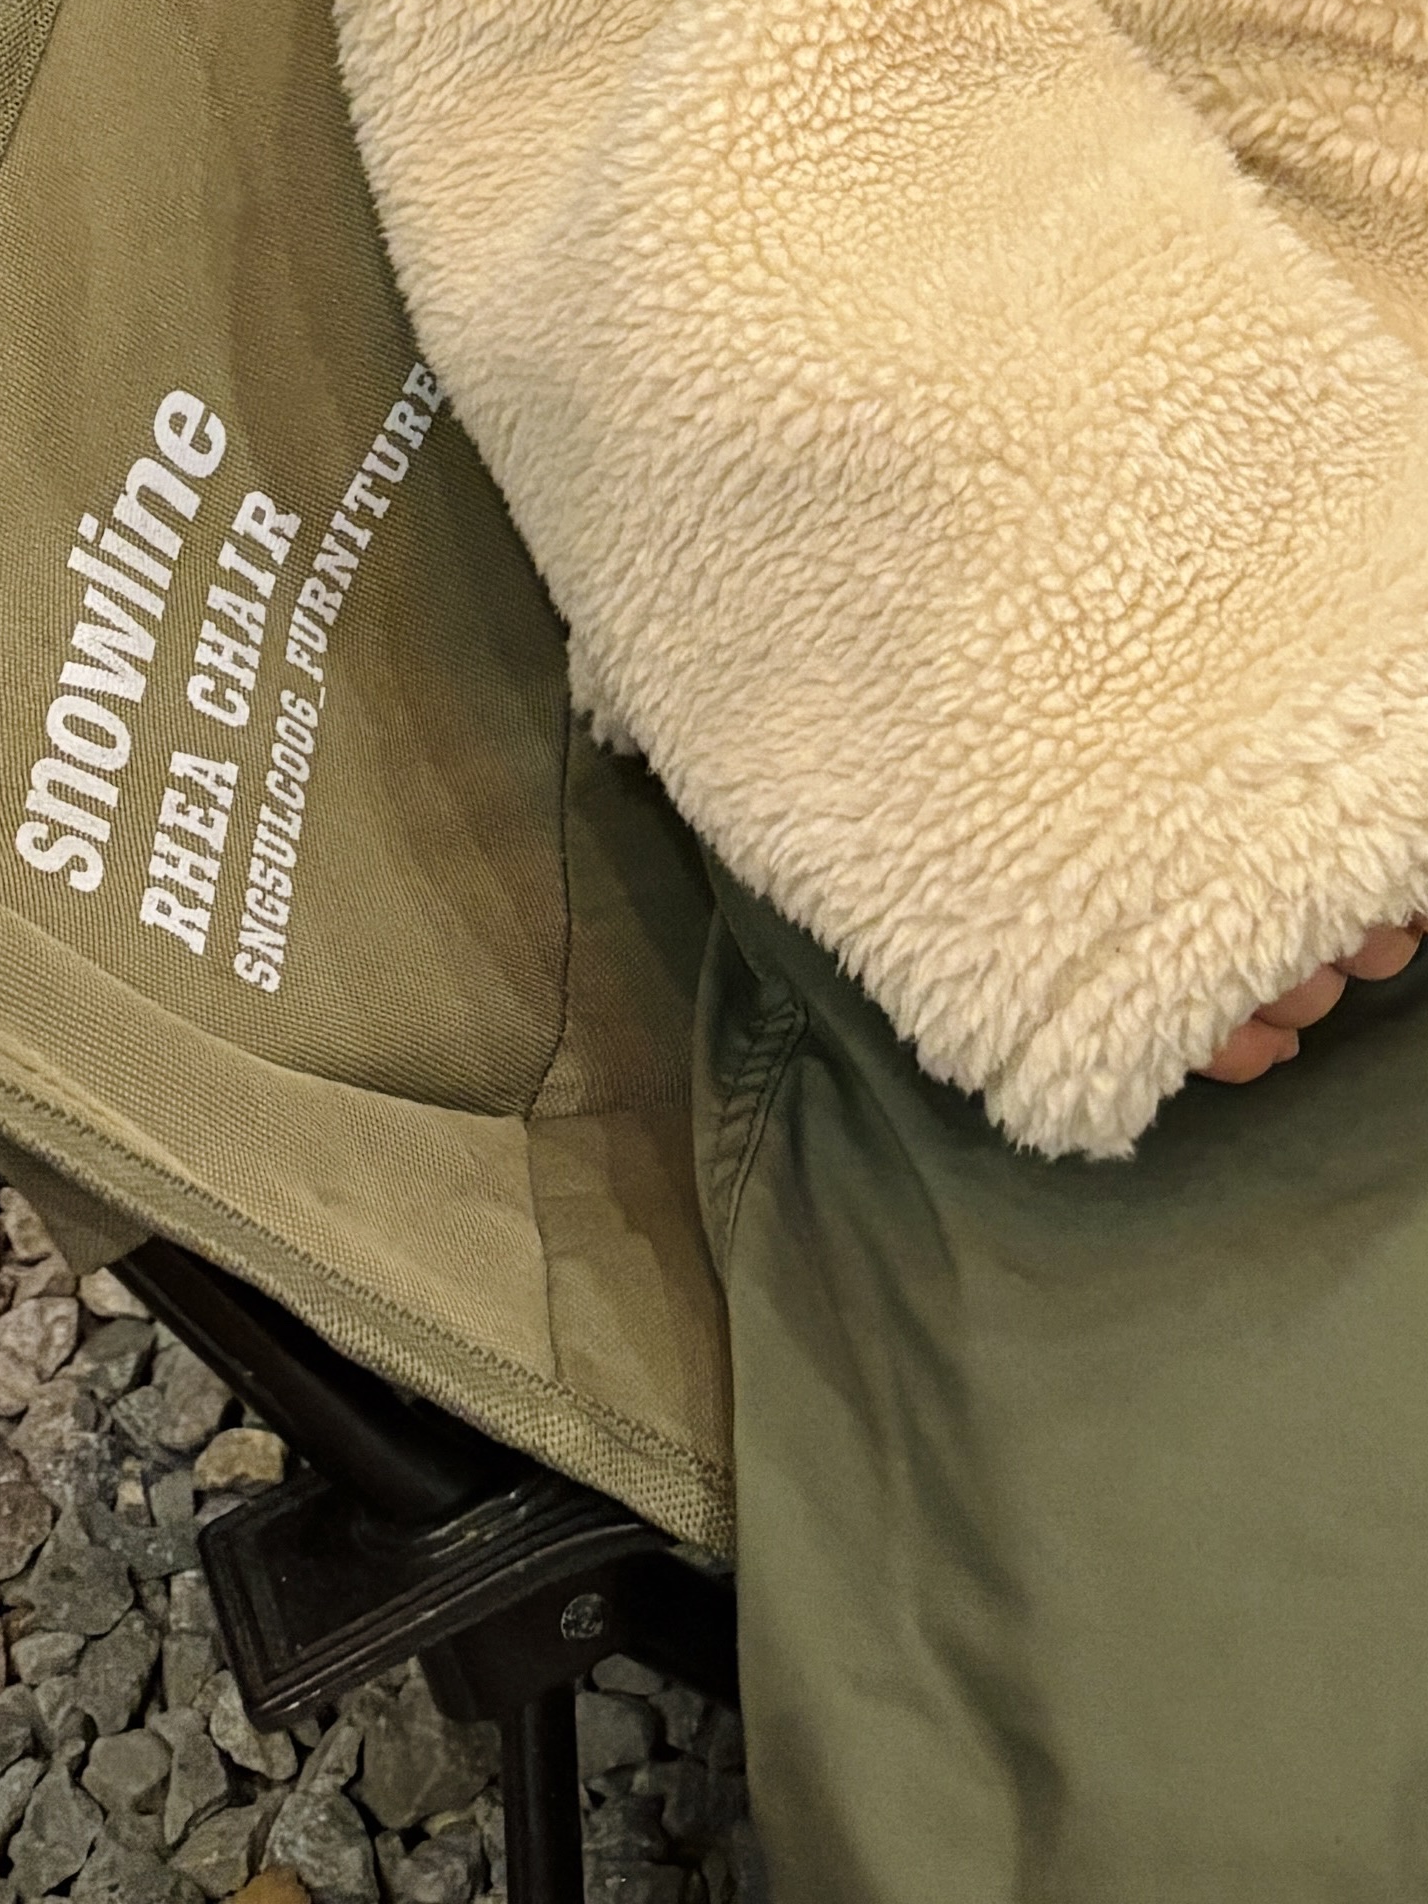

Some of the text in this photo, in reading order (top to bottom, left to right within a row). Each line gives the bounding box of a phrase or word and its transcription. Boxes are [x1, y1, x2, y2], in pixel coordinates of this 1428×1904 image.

[14, 389, 227, 893] snowline
[138, 490, 302, 956] RHEA CHAIR
